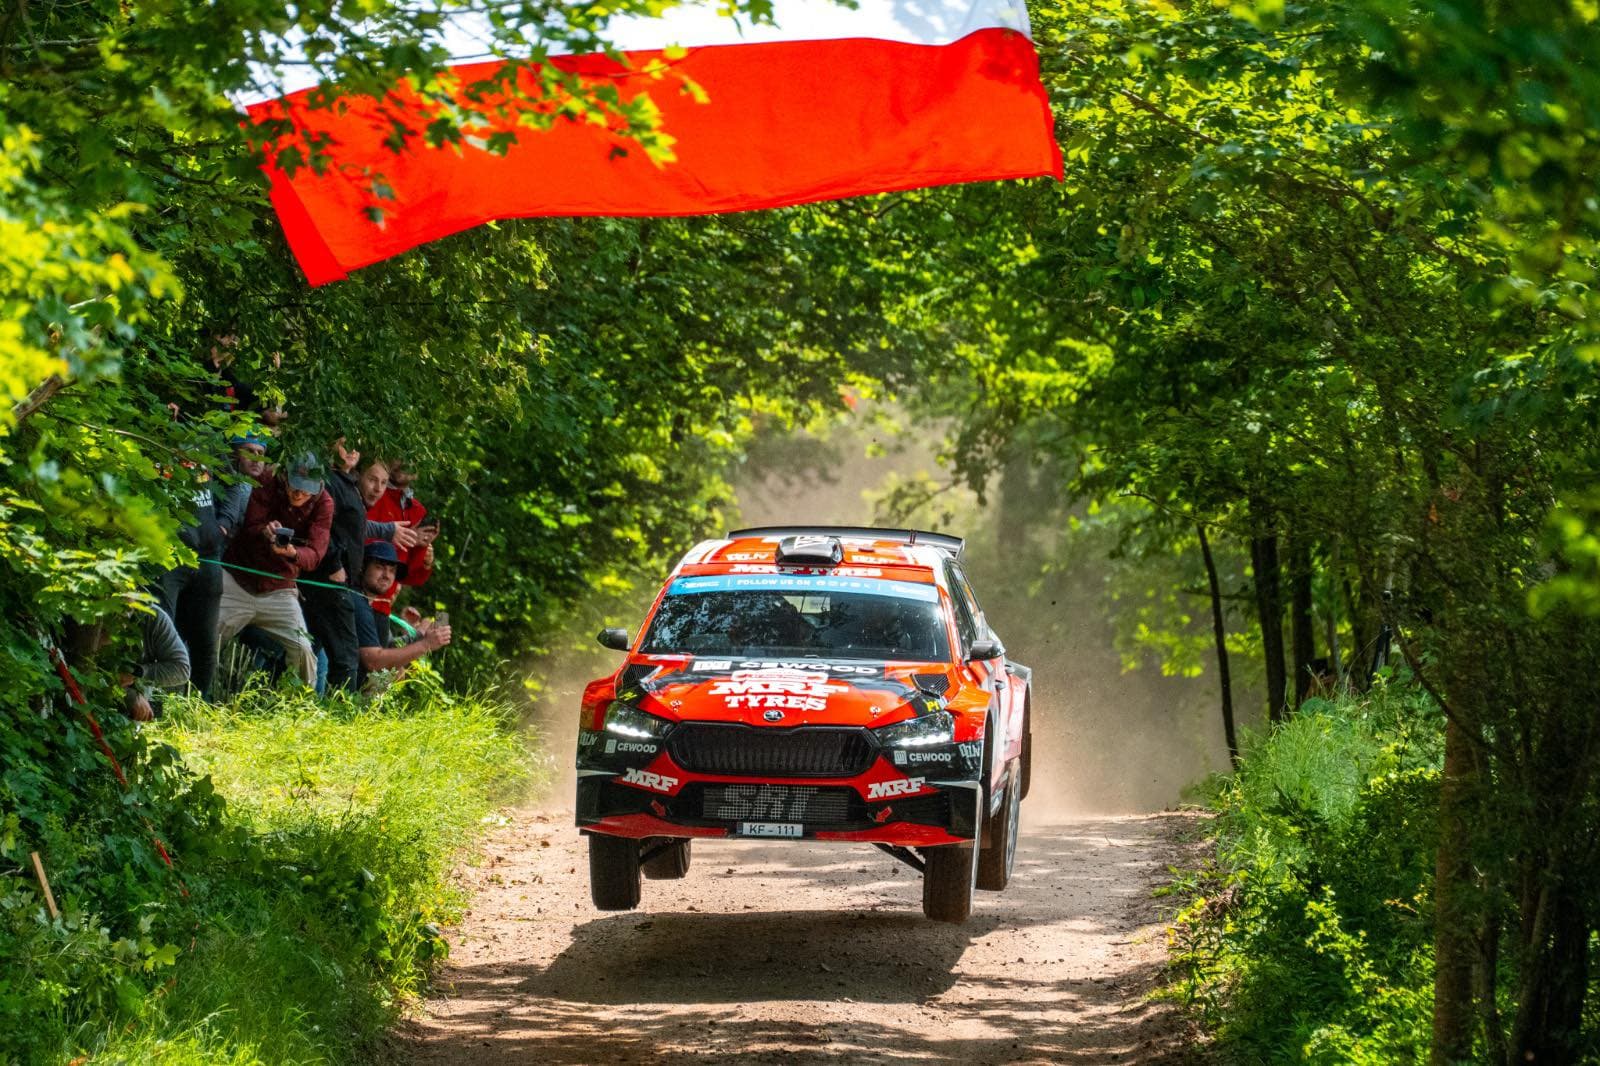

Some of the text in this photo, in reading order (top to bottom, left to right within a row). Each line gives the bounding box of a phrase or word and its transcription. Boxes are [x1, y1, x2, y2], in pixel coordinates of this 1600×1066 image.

[736, 578, 812, 587] FOLLOW US ON
[739, 661, 878, 674] CEWOOD
[708, 681, 849, 697] MRF
[724, 694, 827, 711] TYRES
[617, 742, 658, 753] CEWOOD
[909, 752, 952, 762] CEWOOD
[622, 767, 679, 792] MRF
[867, 776, 926, 799] MRF
